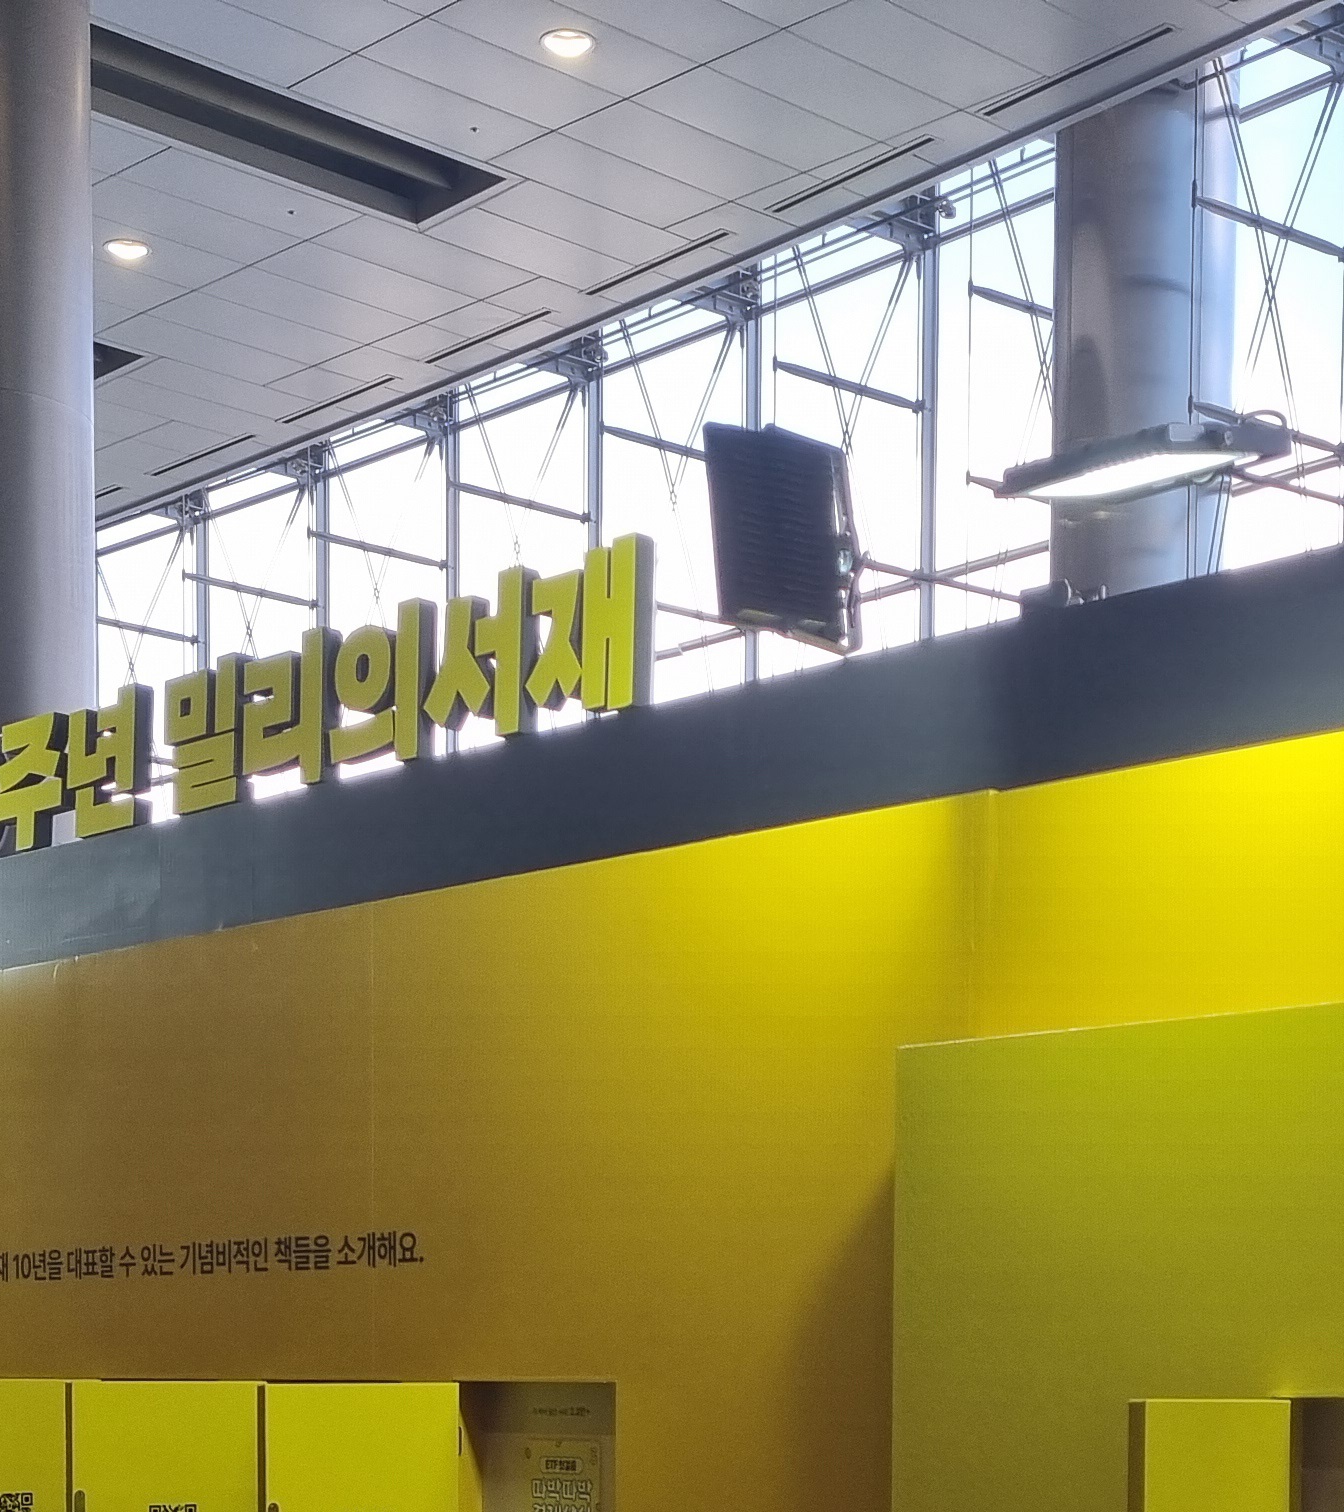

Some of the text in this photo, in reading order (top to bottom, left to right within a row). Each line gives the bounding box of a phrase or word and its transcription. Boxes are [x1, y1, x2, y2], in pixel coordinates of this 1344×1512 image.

[164, 533, 651, 815] 밀리의서재
[13, 1249, 63, 1281] 10년을
[66, 1247, 115, 1279] 대표할
[119, 1249, 136, 1278] 수
[141, 1244, 176, 1277] 있는
[180, 1237, 268, 1276] 기념비적인
[274, 1235, 331, 1271] 책들을
[336, 1232, 424, 1266] 소개해요.
